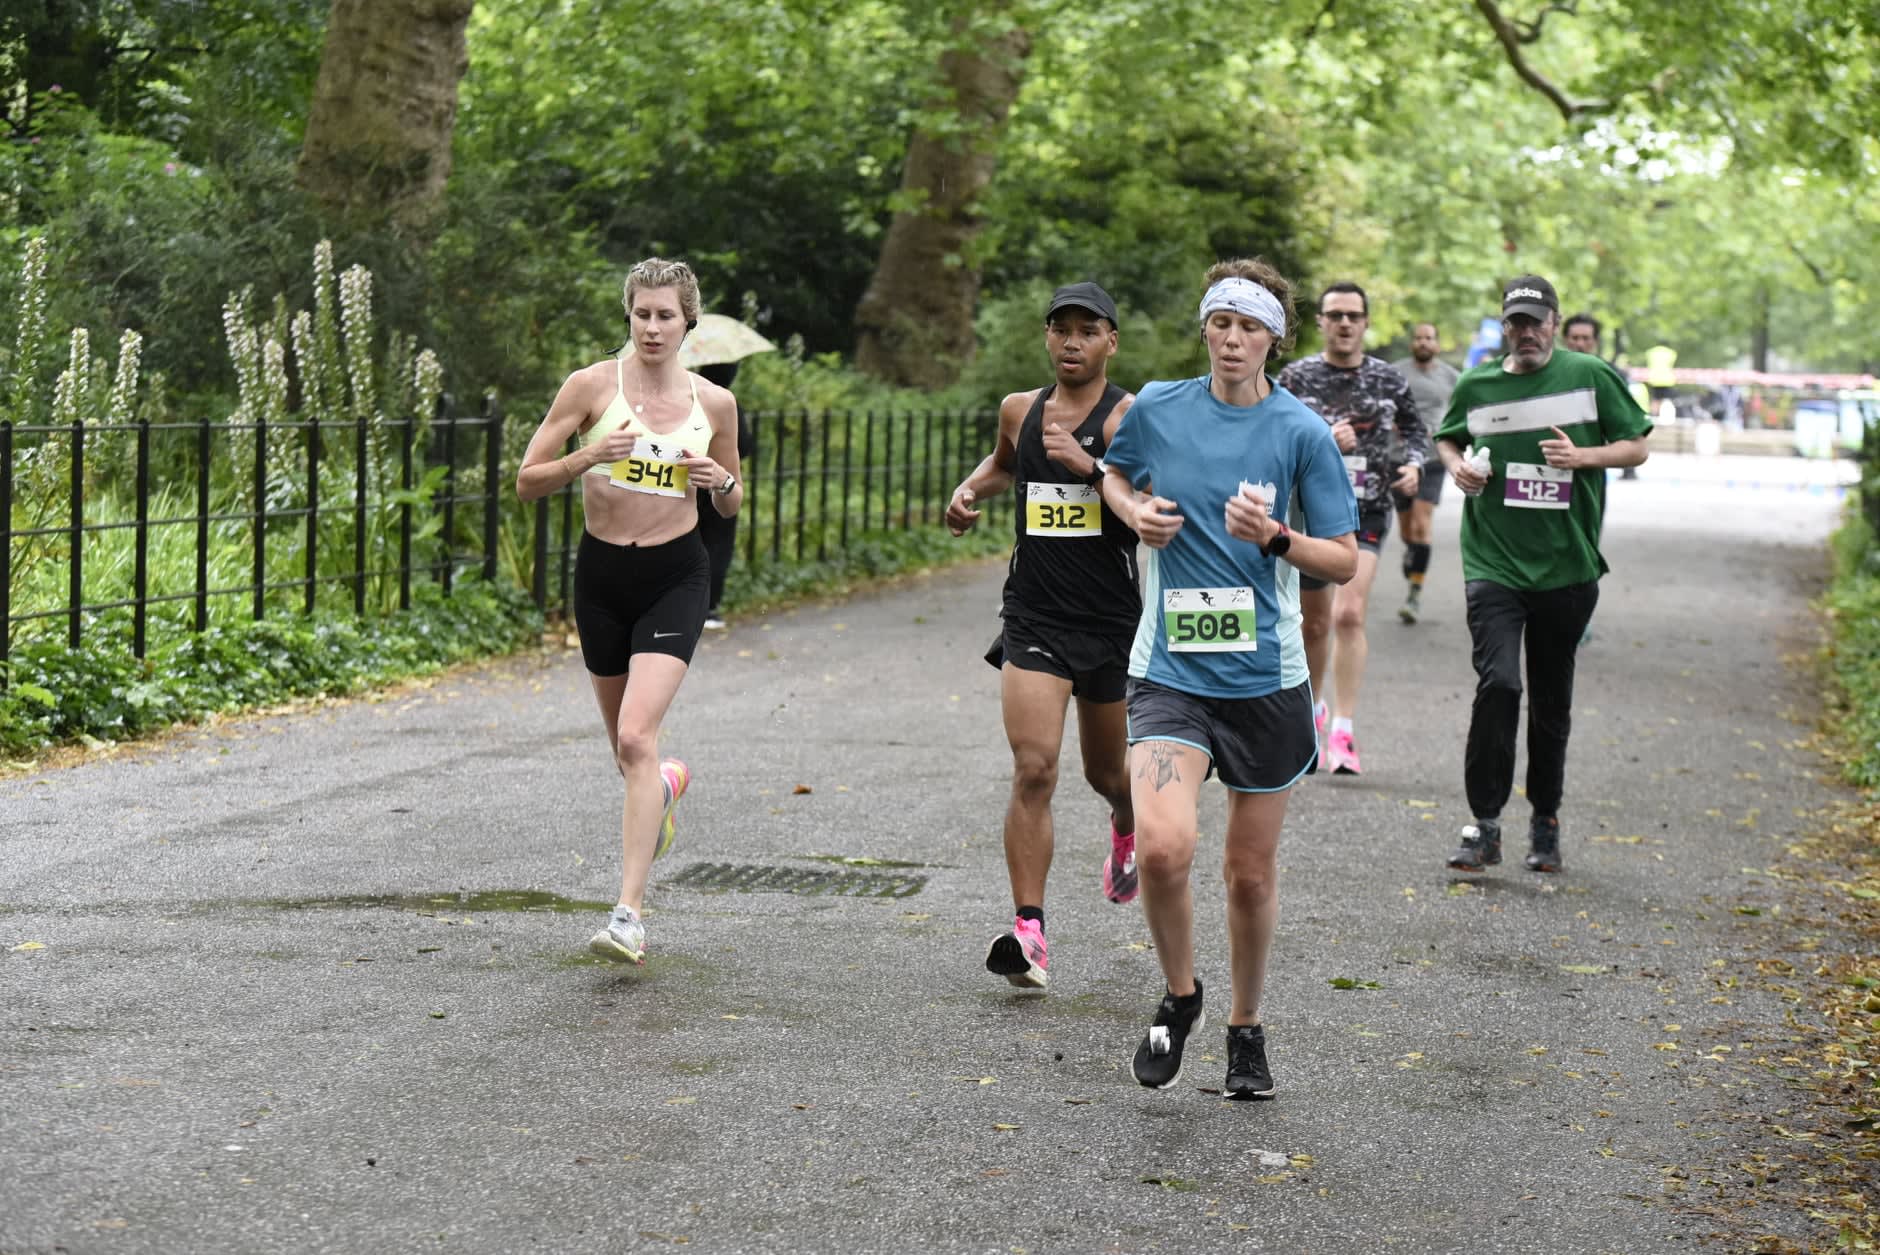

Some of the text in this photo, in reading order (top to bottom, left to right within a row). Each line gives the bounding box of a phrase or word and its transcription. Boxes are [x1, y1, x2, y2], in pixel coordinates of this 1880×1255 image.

[1506, 287, 1542, 301] adidas
[626, 459, 674, 488] 341
[1518, 480, 1560, 501] 412
[1039, 505, 1086, 528] 312
[1177, 613, 1241, 641] 508
